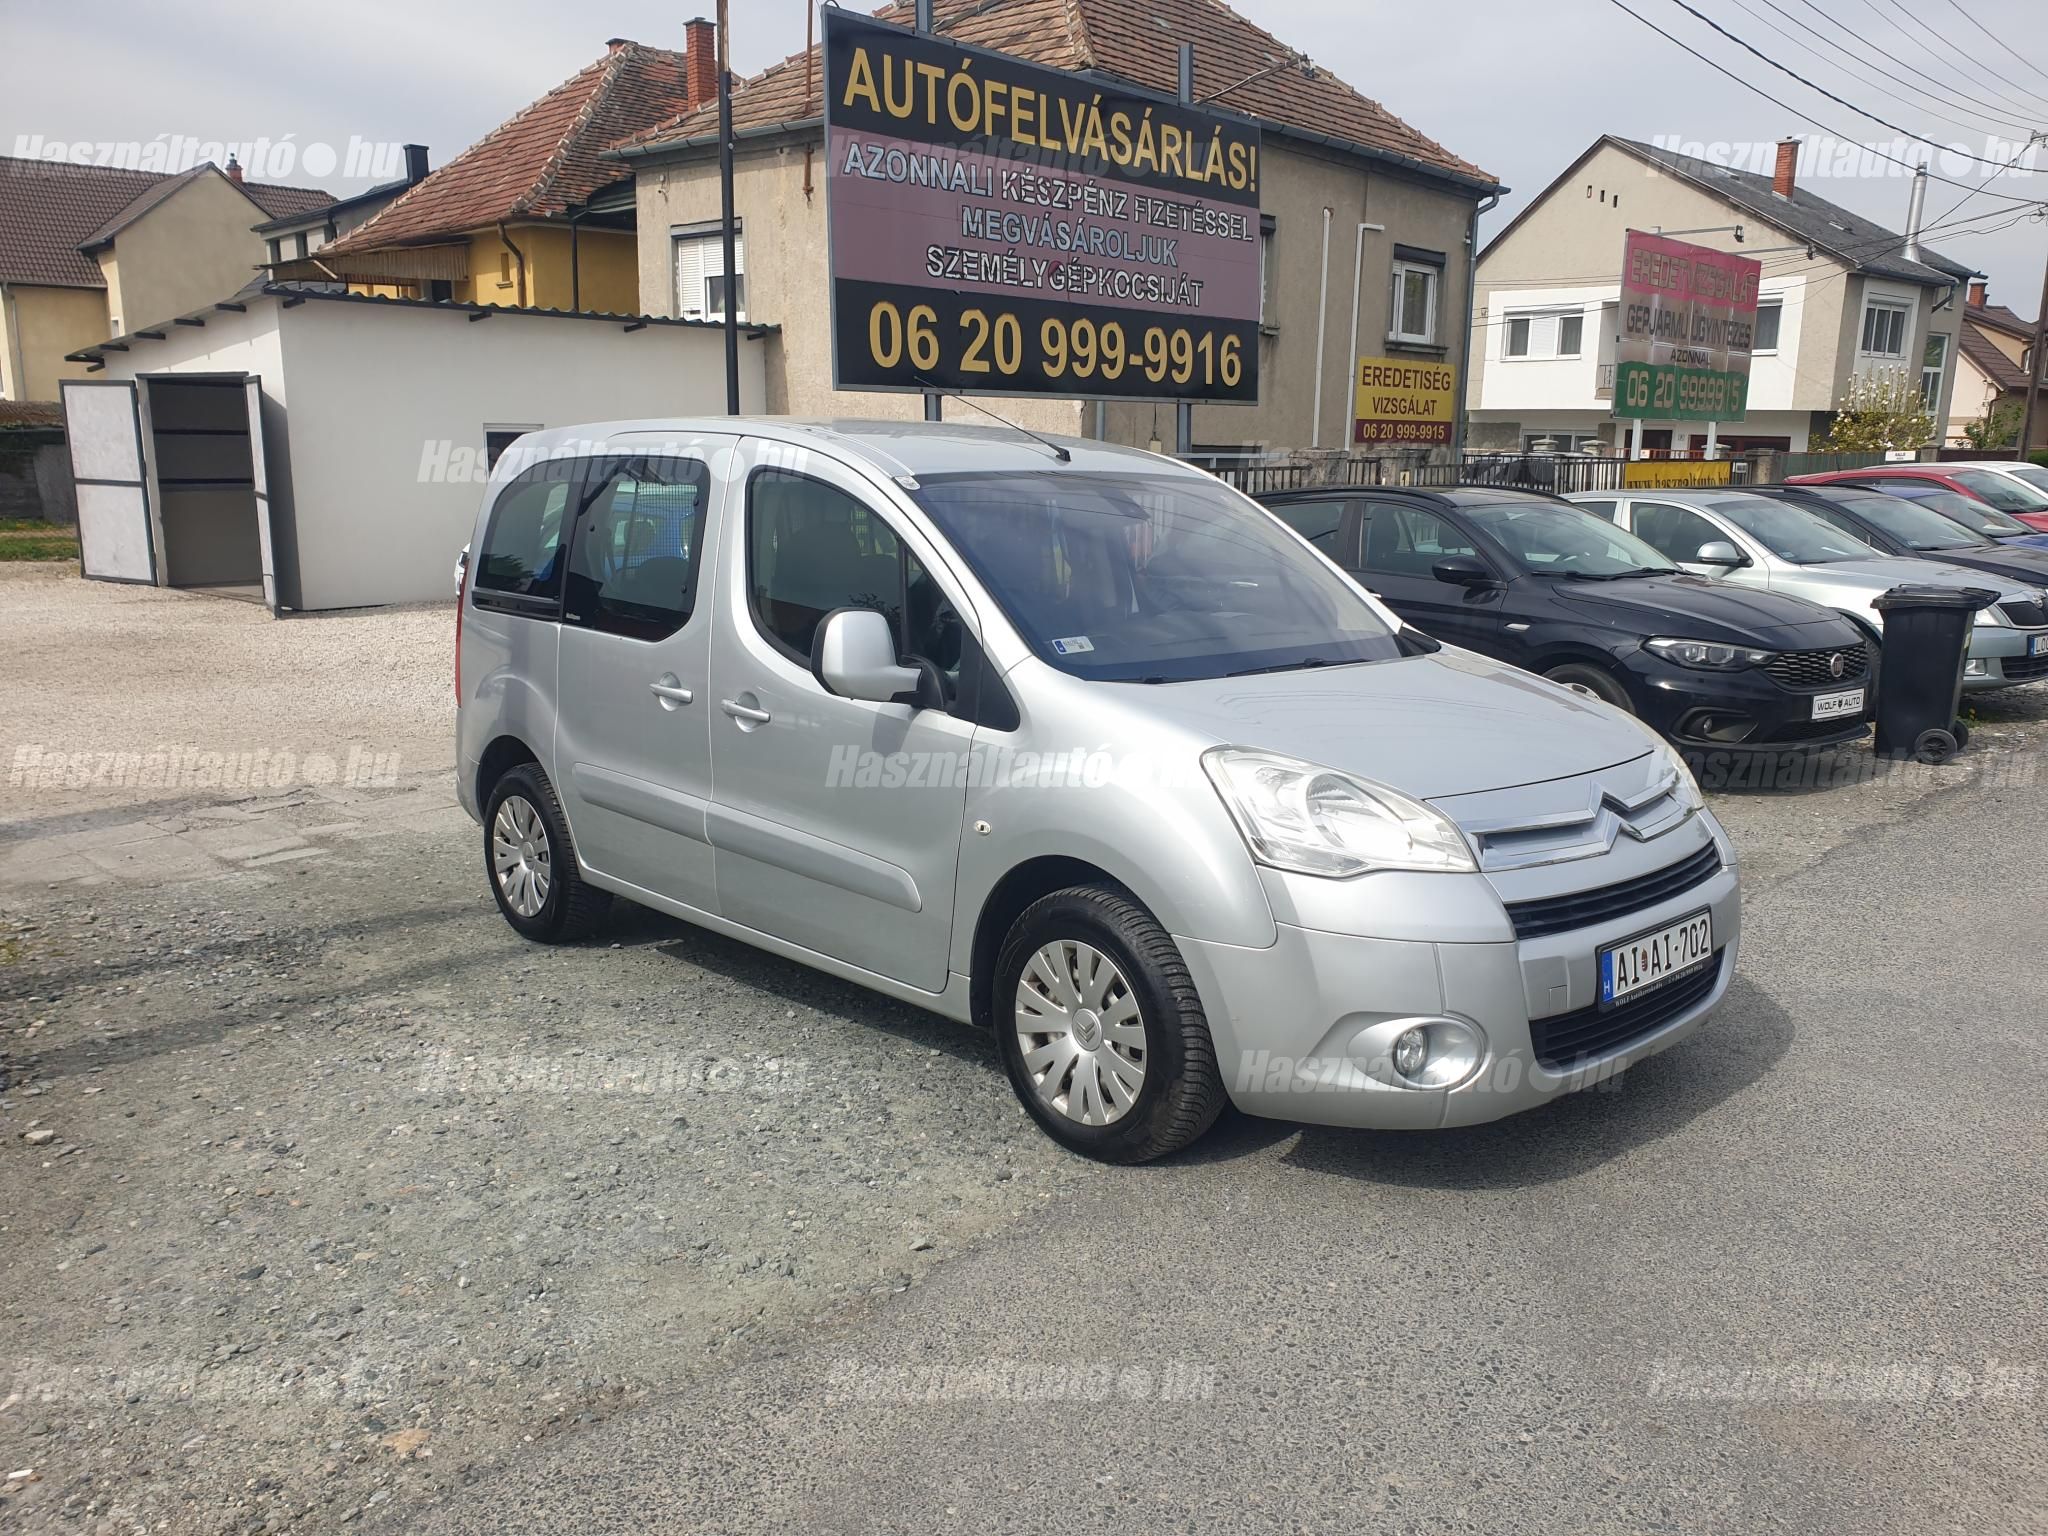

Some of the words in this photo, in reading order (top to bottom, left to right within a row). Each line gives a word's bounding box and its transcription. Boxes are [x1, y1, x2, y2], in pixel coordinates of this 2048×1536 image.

[843, 47, 1257, 192] AUTÓFELVÁSÁRLÁS!
[843, 143, 994, 197] AZONNALI
[1001, 169, 1128, 220] KÉSZPÉNZ
[1134, 196, 1253, 241] FIZETÉSSEL
[961, 206, 1178, 267] MEGVÁSÁROLJUK
[869, 301, 939, 371] 06
[959, 309, 1022, 375] 20
[1040, 317, 1242, 387] 999-9916
[1362, 366, 1451, 391] EREDETISÉG
[1627, 370, 1649, 407] 06
[1654, 372, 1675, 408] 20
[1372, 395, 1437, 416] VIZSGÁLAT
[1363, 424, 1377, 438] 06
[1380, 424, 1393, 438] 20
[1397, 424, 1444, 439] 999-9915
[1818, 701, 1837, 711] WOLF
[1844, 697, 1860, 707] AUTO
[1603, 981, 1610, 994] H
